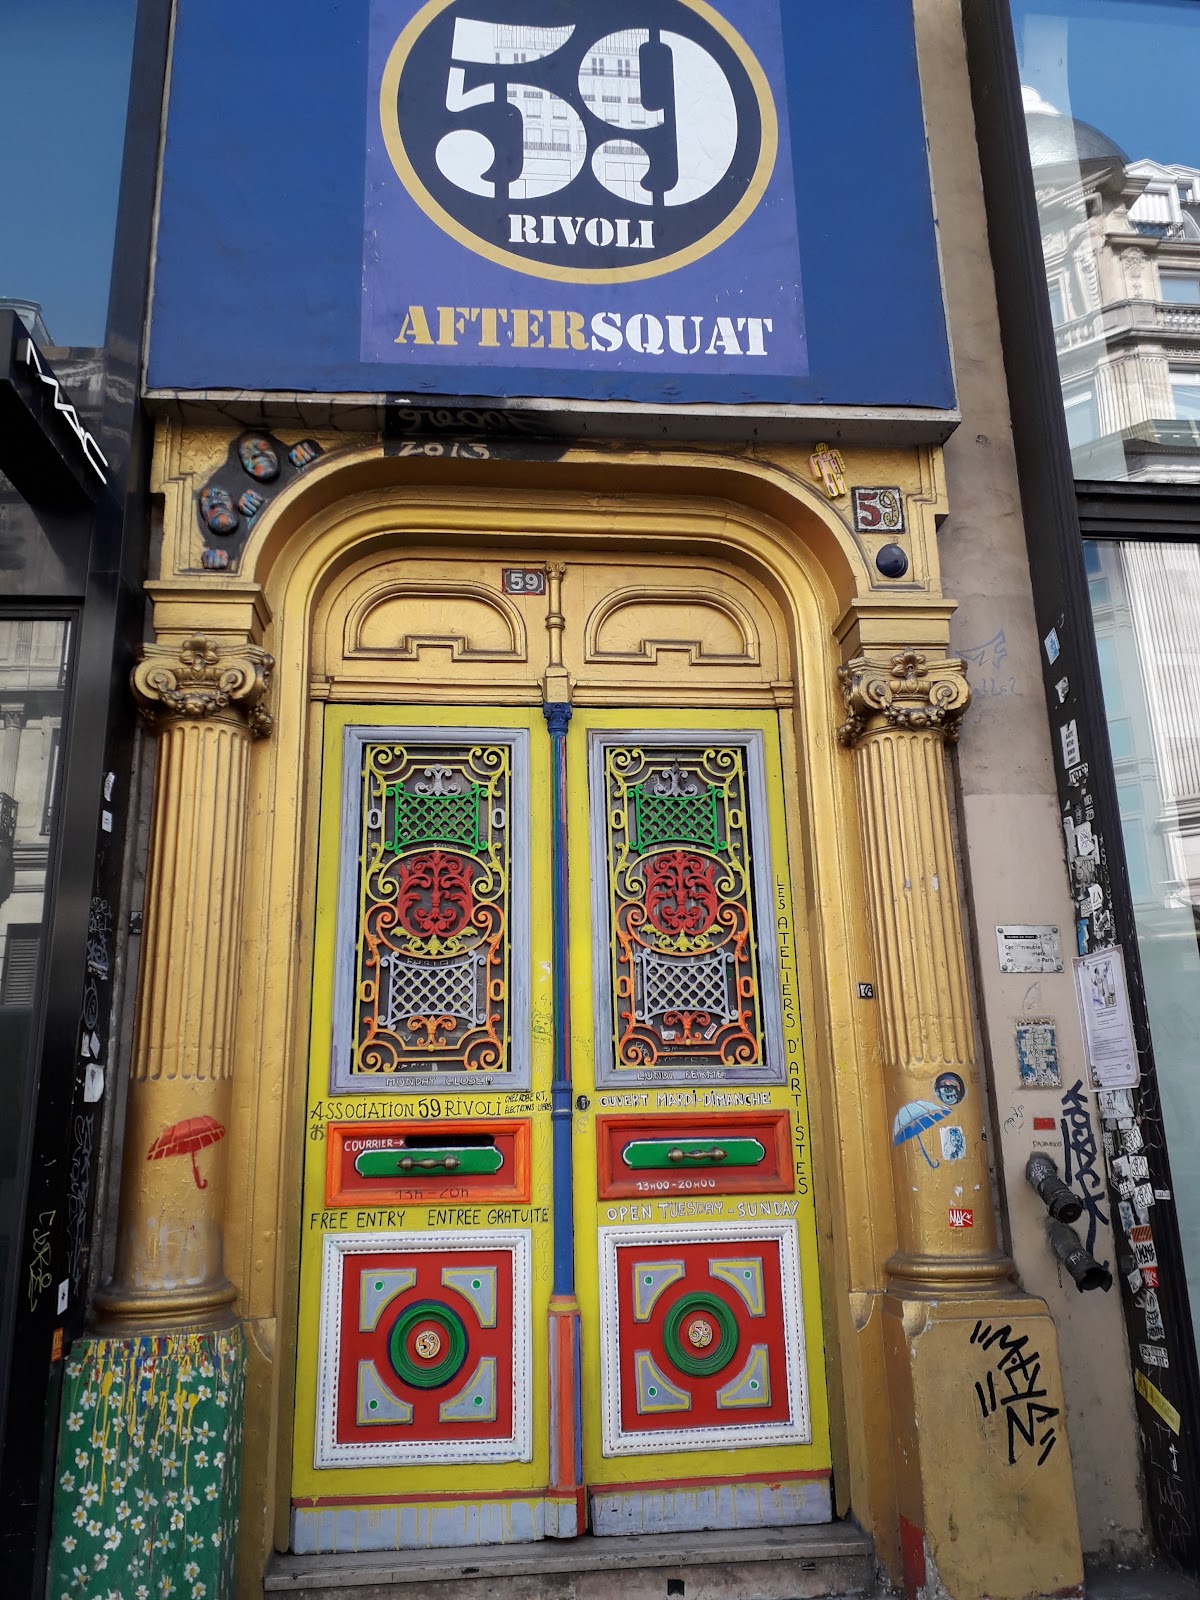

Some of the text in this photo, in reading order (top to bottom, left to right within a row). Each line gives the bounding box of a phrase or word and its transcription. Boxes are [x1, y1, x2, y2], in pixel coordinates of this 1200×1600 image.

[435, 17, 738, 207] 59
[508, 214, 655, 249] RIVOLI
[858, 490, 899, 527] 59
[510, 572, 538, 590] 59
[777, 916, 796, 1029] ATELIERS
[386, 1075, 495, 1087] MONDAY CLOSED
[310, 1096, 502, 1121] ASSOCIATION 59 RIVOLI
[599, 1094, 649, 1109] OUVERT
[344, 1138, 394, 1152] COURRIER
[310, 1206, 550, 1231] FREE ENTRY ENTRÉE GRATUITE
[606, 1203, 652, 1222] OPEN
[656, 1201, 724, 1218] TUESDAY
[736, 1200, 799, 1217] SUNDAY
